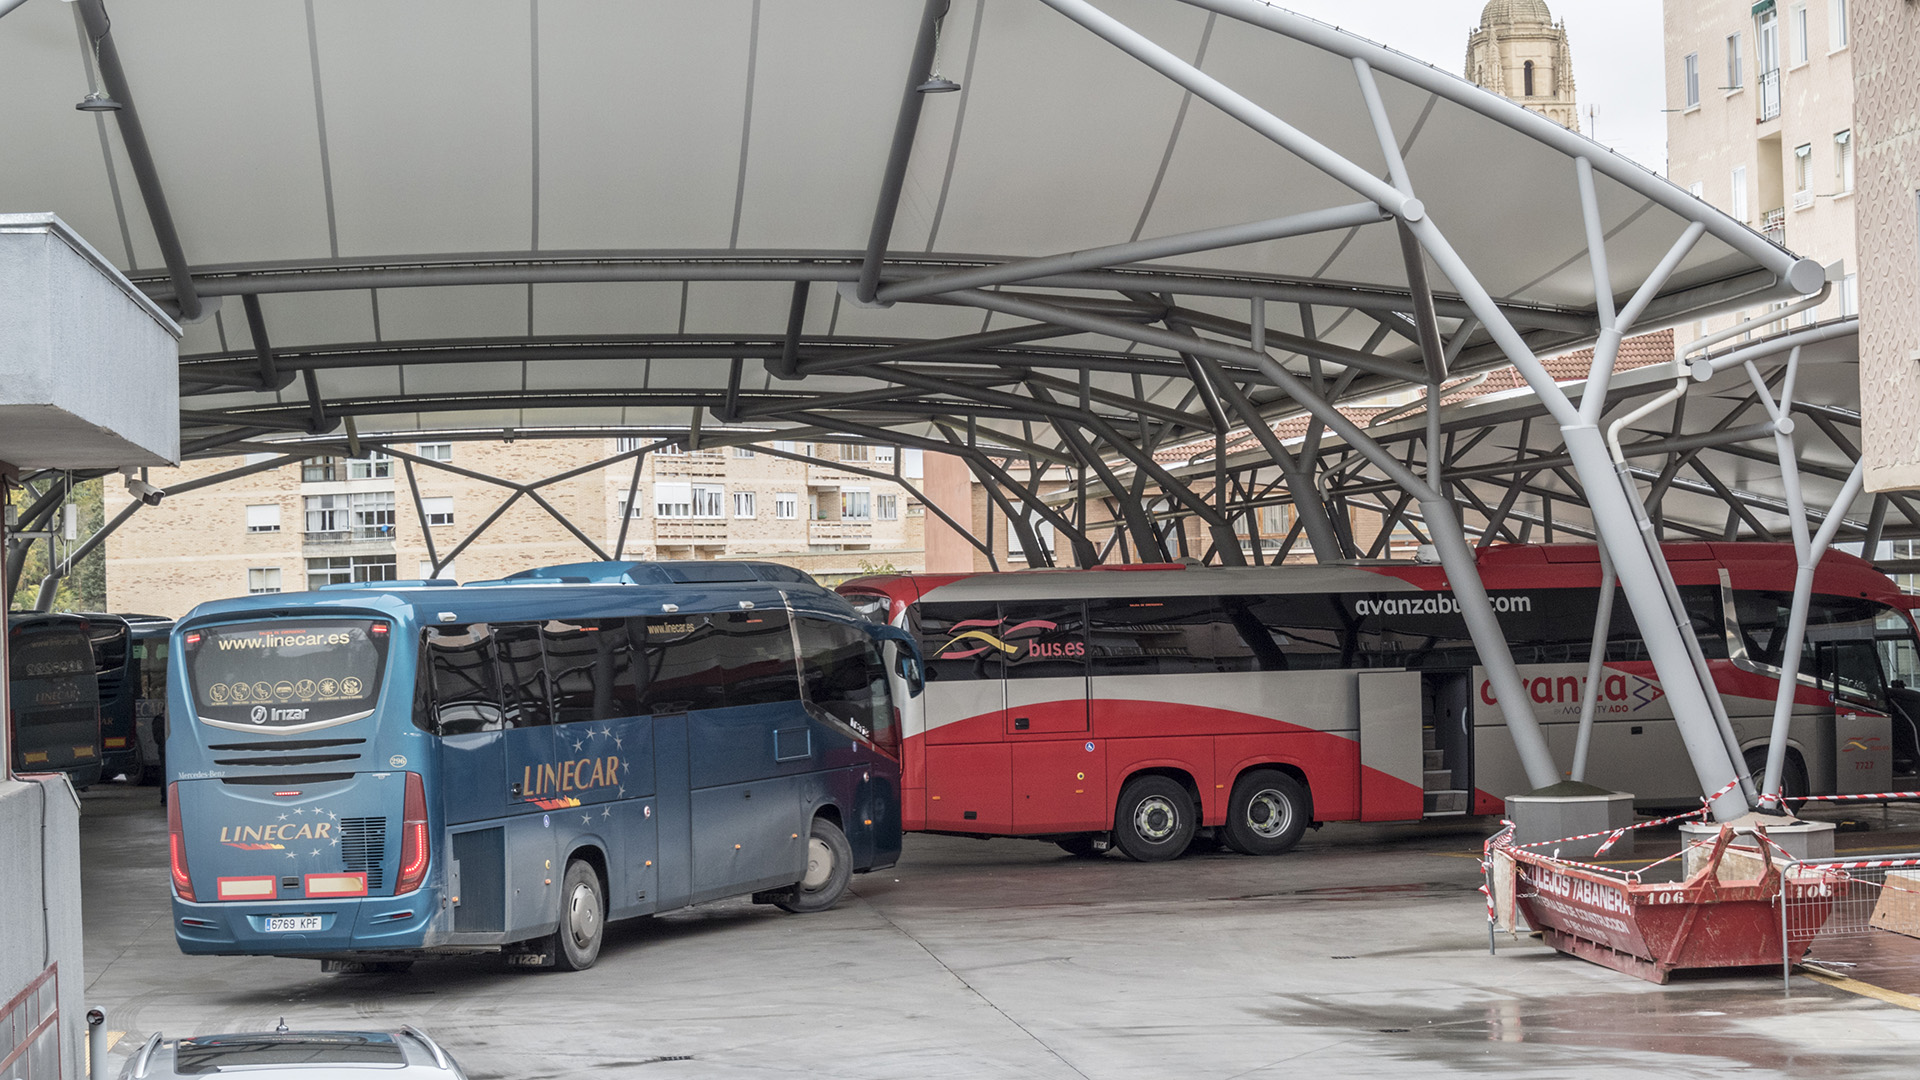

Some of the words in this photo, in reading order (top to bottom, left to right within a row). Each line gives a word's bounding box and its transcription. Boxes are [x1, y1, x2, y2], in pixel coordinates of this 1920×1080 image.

[647, 622, 695, 634] www.linecar.es
[218, 633, 350, 650] www.linecar.es
[1028, 638, 1085, 657] bus.es
[1608, 704, 1629, 713] ADO
[1855, 761, 1875, 770] 7727
[177, 770, 226, 779] Mercedes-Benz
[522, 755, 620, 797] LINECAR
[220, 822, 332, 843] LINECAR
[1572, 878, 1632, 916] TABANERA
[1647, 891, 1685, 905] 106
[271, 918, 296, 930] 6769
[300, 917, 319, 928] KPF
